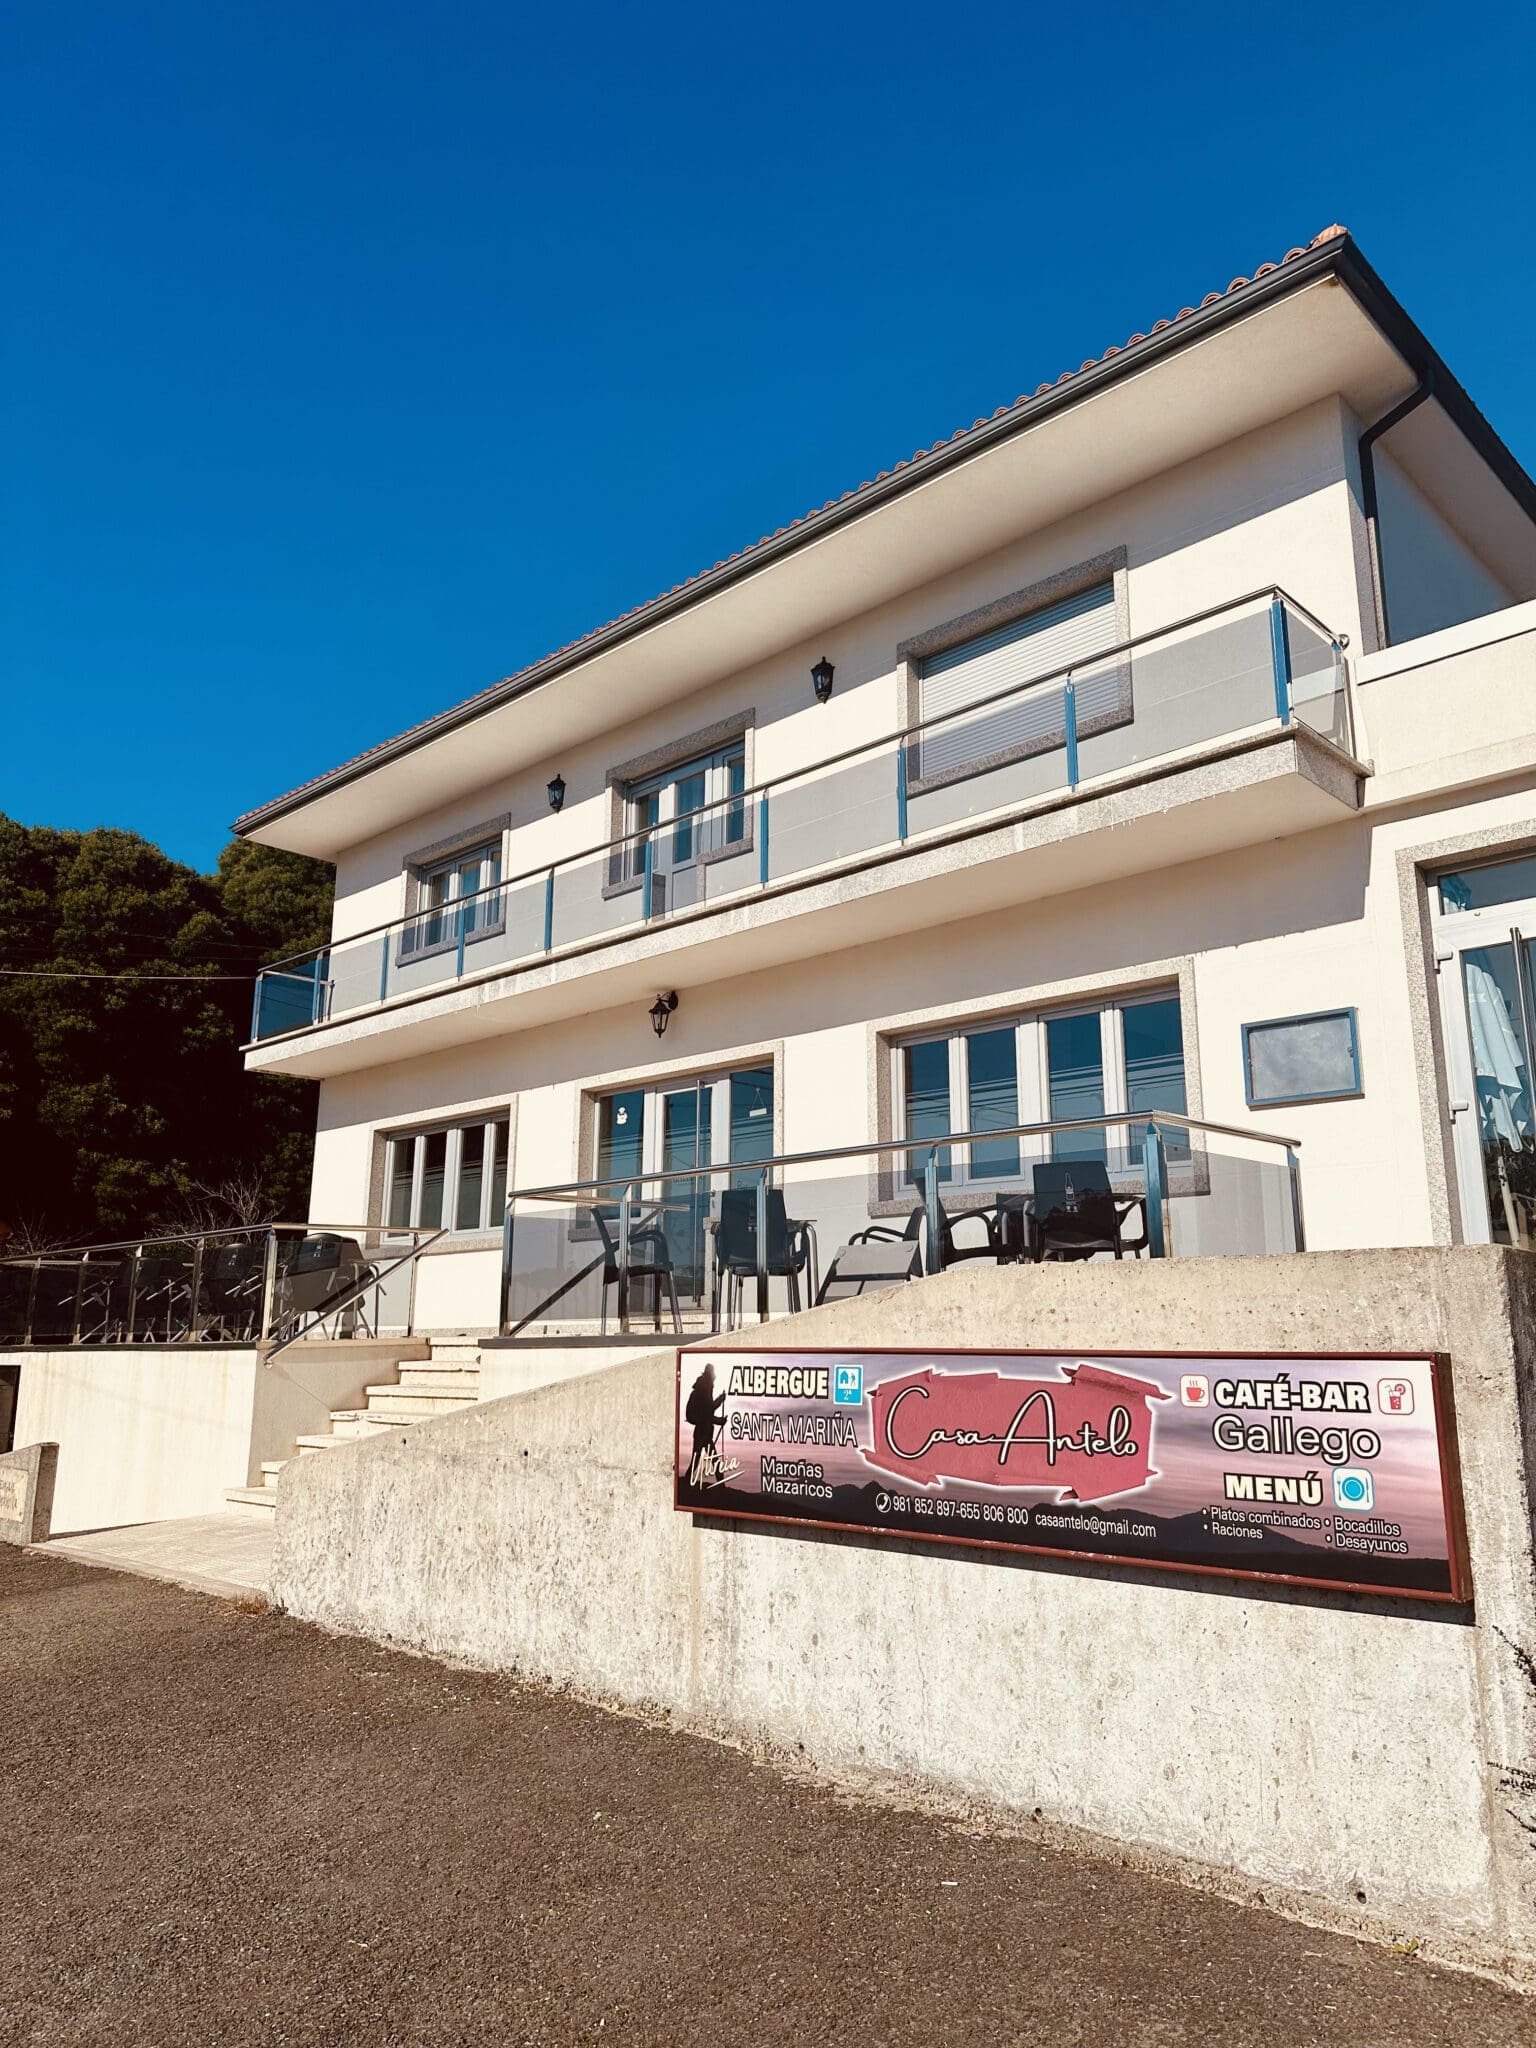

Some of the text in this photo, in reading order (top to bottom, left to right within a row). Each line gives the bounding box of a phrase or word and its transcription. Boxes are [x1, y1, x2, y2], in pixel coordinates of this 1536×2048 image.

[728, 1366, 829, 1399] ALBERGUE
[1214, 1372, 1372, 1413] CAFÉ-BAR
[730, 1412, 858, 1447] SANTA MARIÑA
[886, 1386, 1138, 1466] Casa Antelo
[1212, 1414, 1381, 1466] Gallego
[761, 1456, 823, 1479] Maroñas
[762, 1476, 833, 1498] Mazaricos
[1223, 1470, 1324, 1506] MENÚ
[893, 1496, 1028, 1525] 981 852 897-655 806 800
[1210, 1507, 1321, 1529] Platos combinados
[1035, 1514, 1156, 1538] casaantelo@gmail.com
[1212, 1523, 1264, 1539] Raciones
[1335, 1517, 1401, 1536] Bocadillos
[1335, 1534, 1408, 1553] Desayunos
